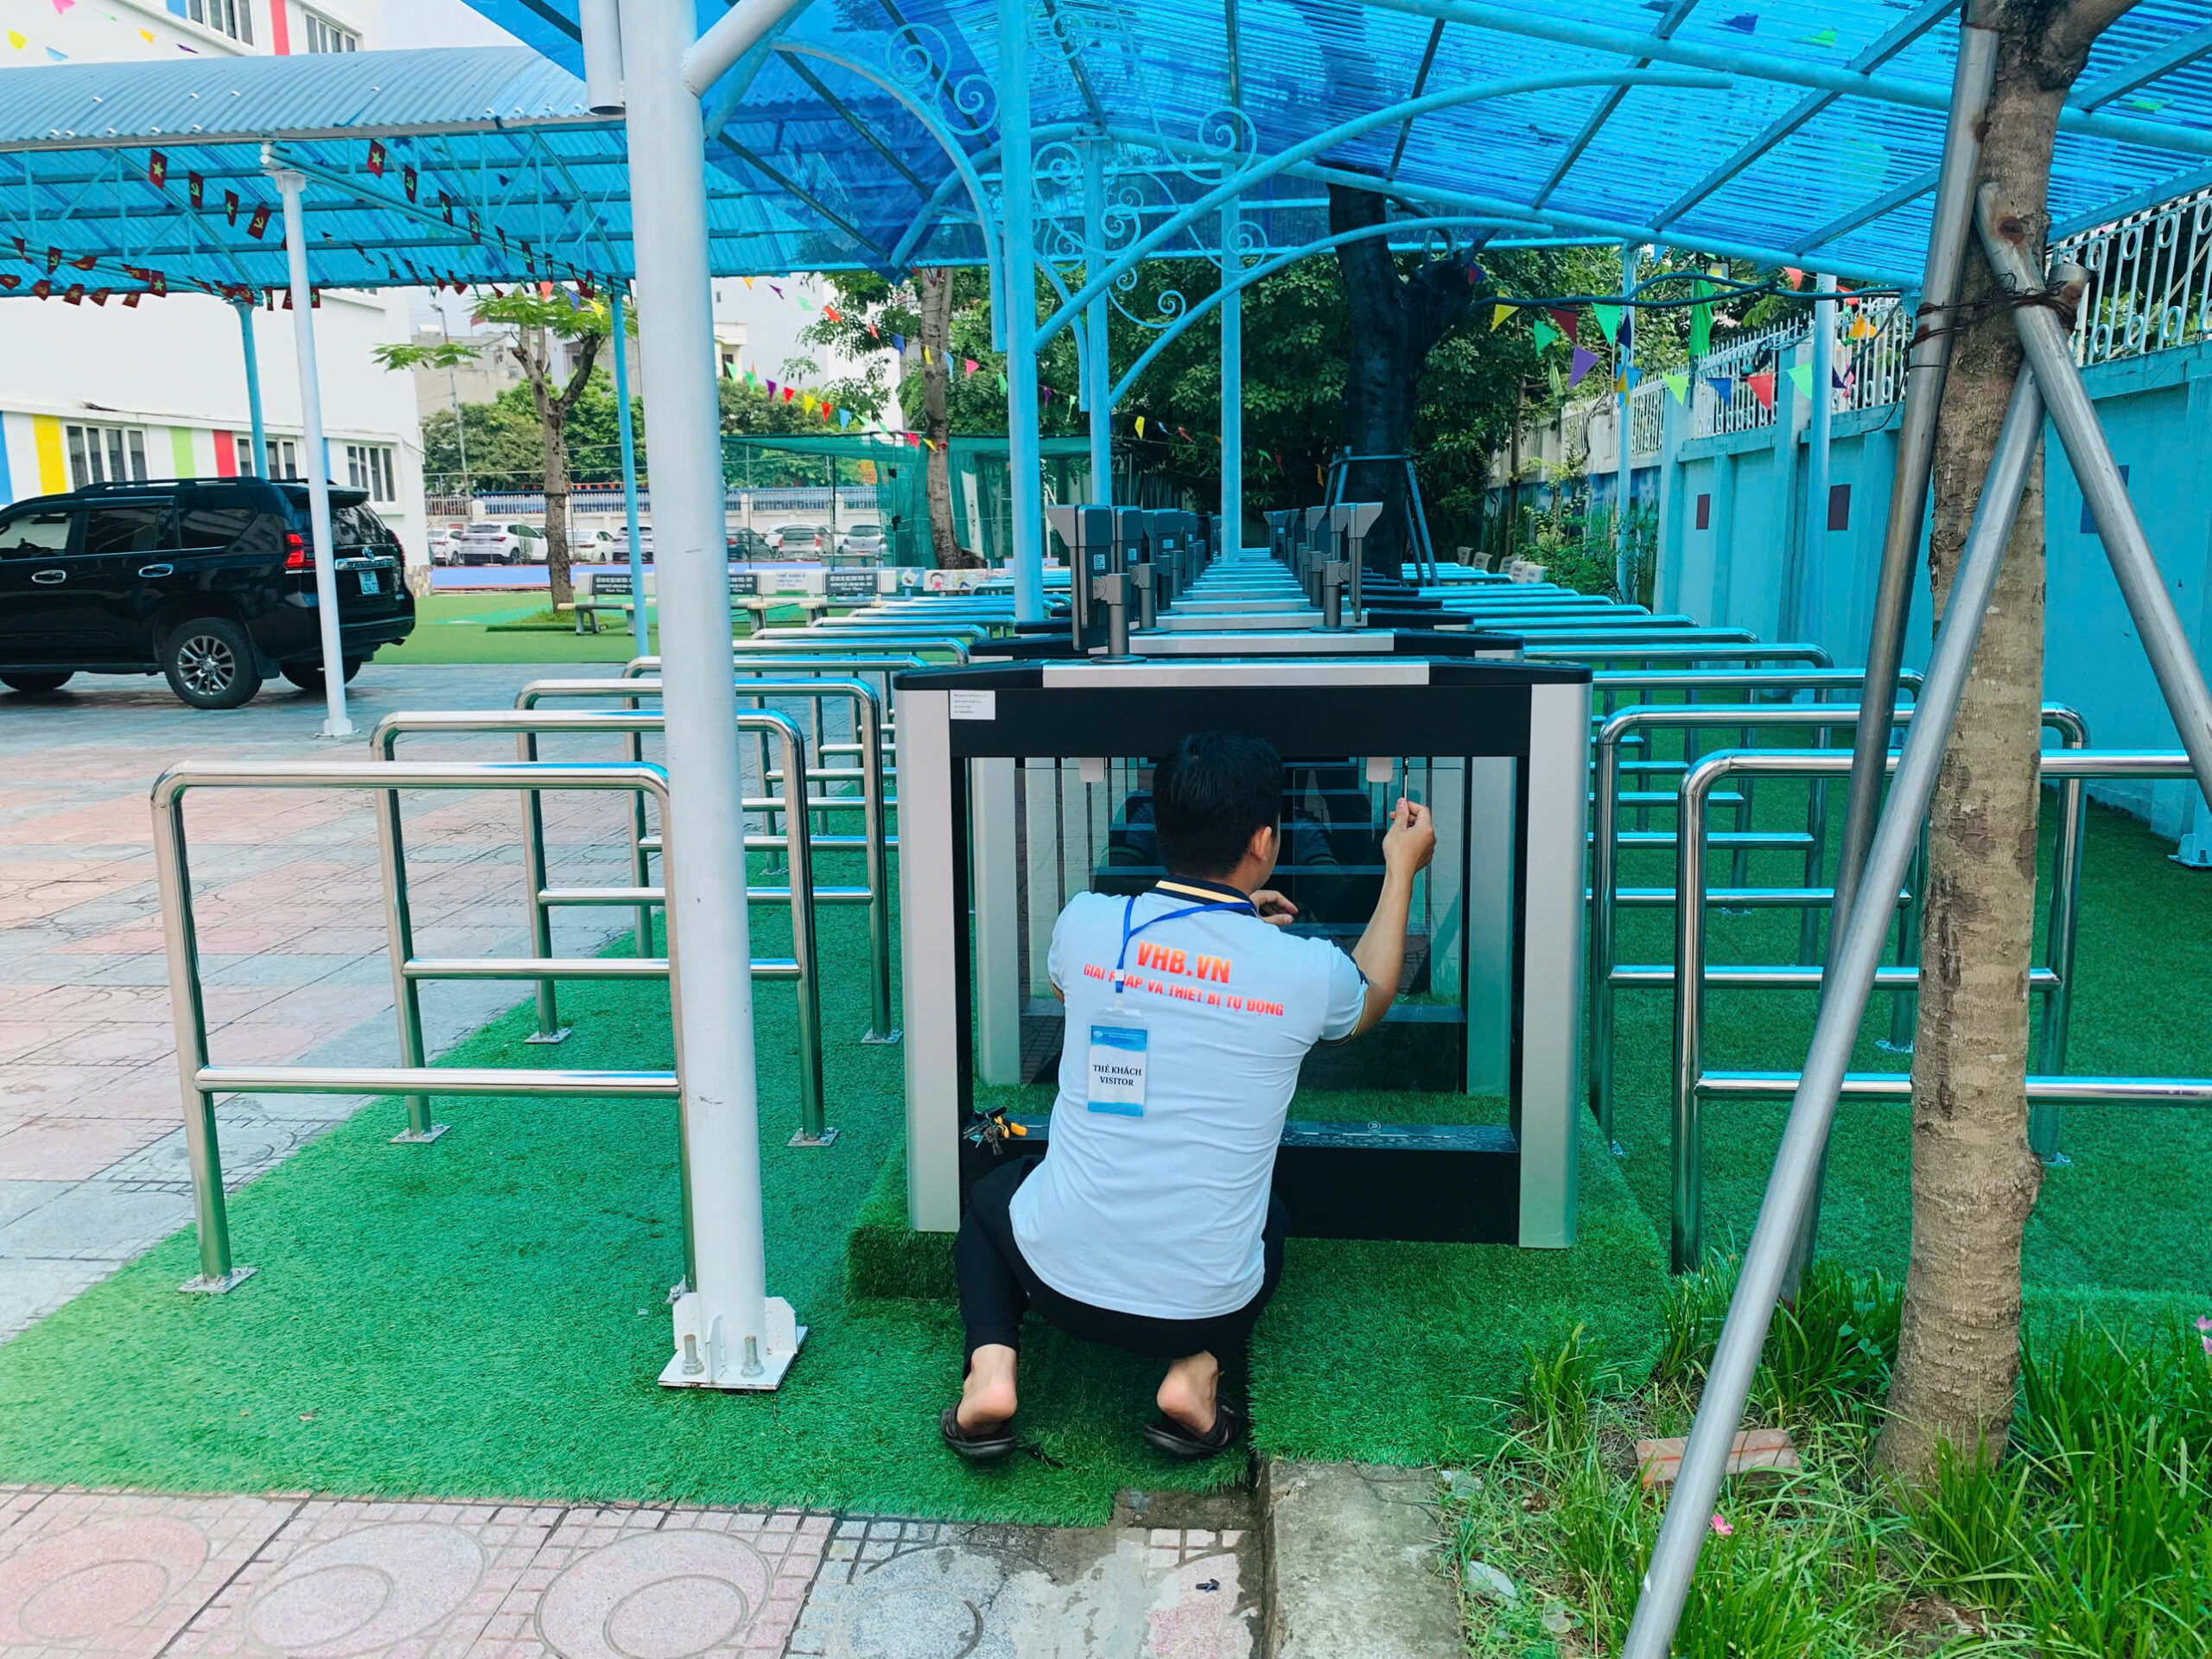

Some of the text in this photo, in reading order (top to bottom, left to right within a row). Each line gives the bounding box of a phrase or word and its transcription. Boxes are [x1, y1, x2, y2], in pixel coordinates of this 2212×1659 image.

[1137, 940, 1231, 983] VHB.VN
[1207, 992, 1222, 1008] BỊ
[1226, 995, 1244, 1012] TỰ
[1247, 998, 1284, 1016] ĐỘNG
[1092, 1064, 1142, 1076] THẺ KHÁCH
[1100, 1076, 1134, 1086] VISITOR
